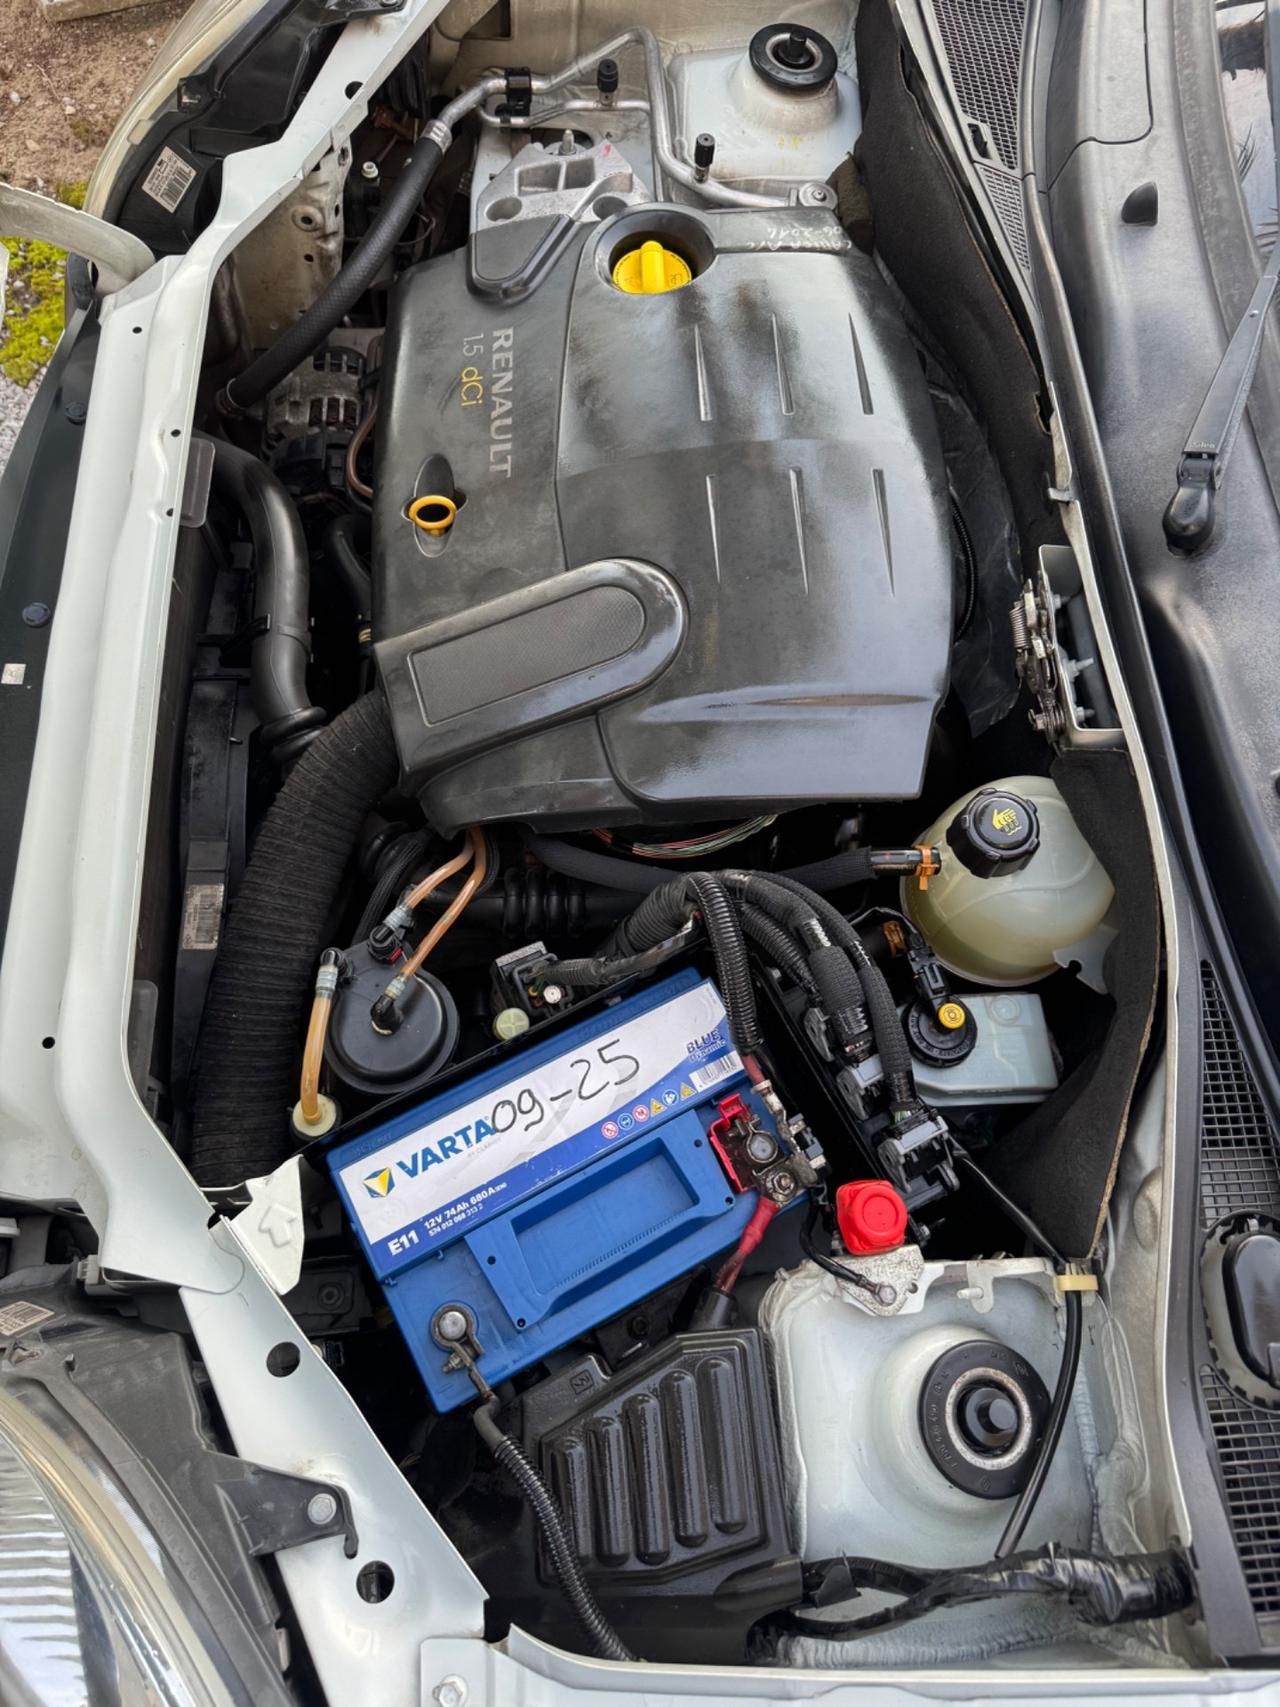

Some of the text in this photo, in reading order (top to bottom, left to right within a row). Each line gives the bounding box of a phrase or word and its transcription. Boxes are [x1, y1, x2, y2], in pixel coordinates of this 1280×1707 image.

[460, 332, 484, 406] 1.5 dCi
[489, 327, 513, 478] RENAULT
[686, 1029, 724, 1054] BLUE
[491, 1039, 640, 1134] 09-25
[396, 1118, 497, 1179] VARTA
[387, 1229, 420, 1256] E11
[424, 1214, 443, 1229] 12V
[444, 1202, 469, 1219] 74Ah
